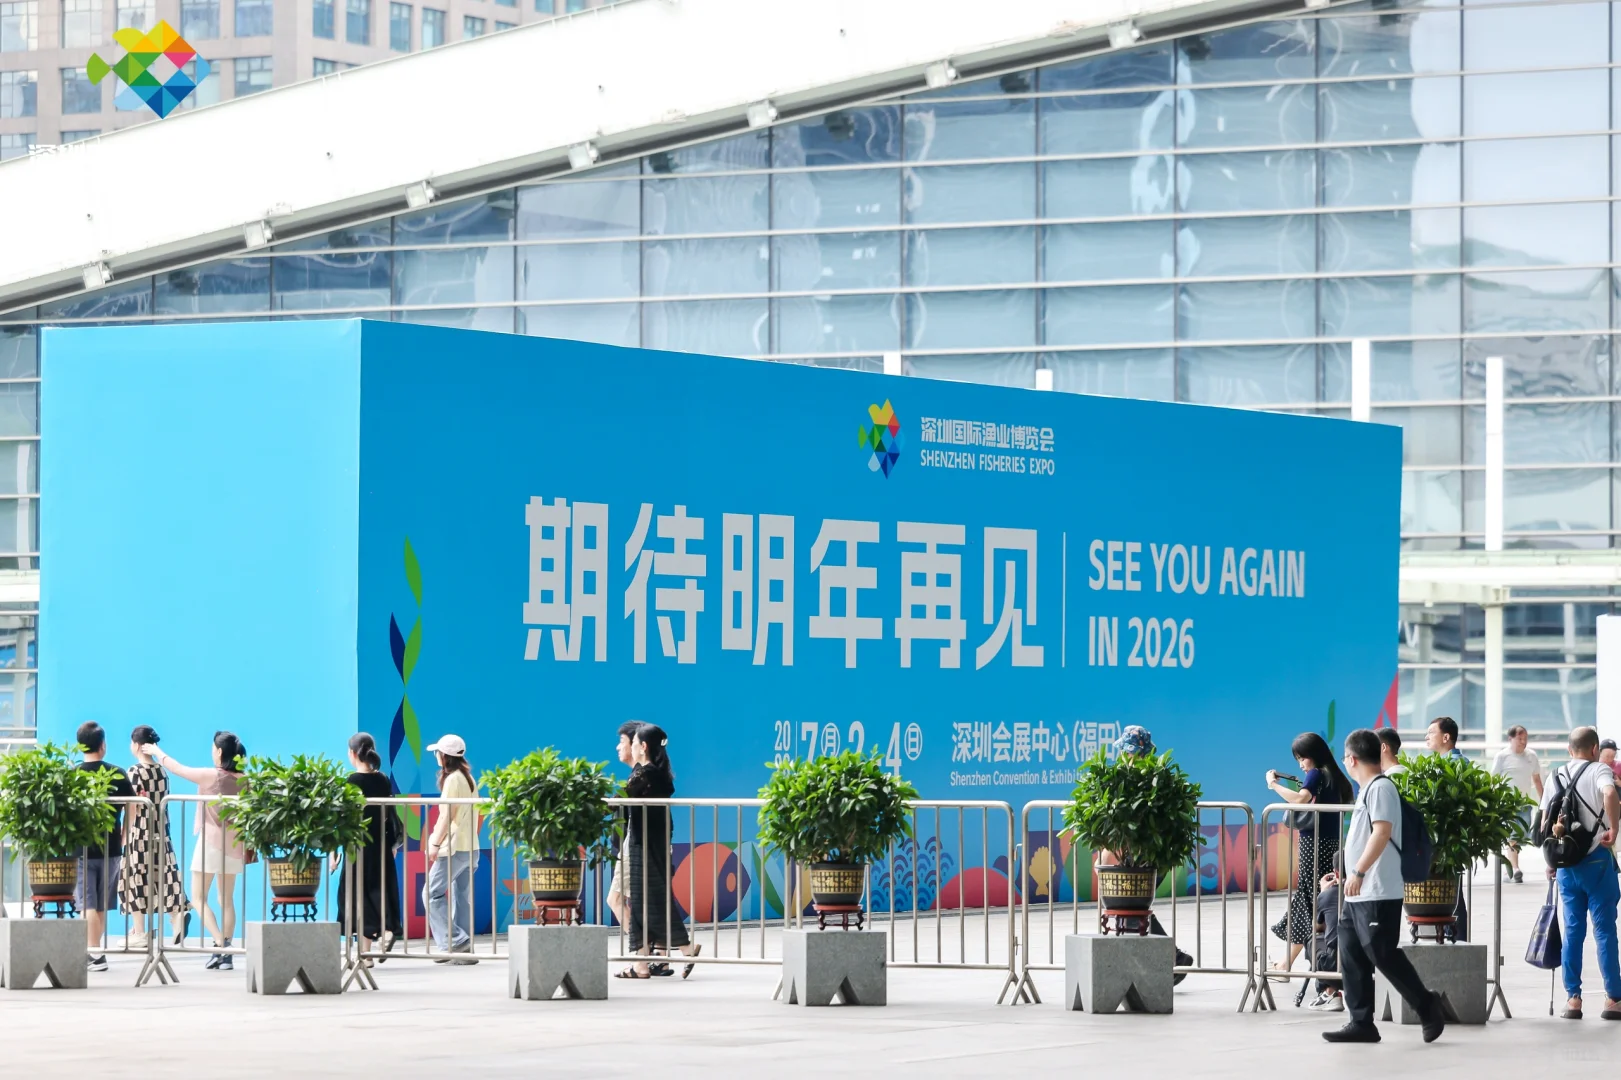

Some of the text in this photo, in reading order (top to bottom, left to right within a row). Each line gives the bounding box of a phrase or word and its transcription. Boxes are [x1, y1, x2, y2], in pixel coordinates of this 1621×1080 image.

[920, 416, 1055, 452] 深圳国际渔业博览会
[920, 449, 1055, 476] SHENZHEN FISHERIES EXPO
[522, 495, 1045, 671] 期待明年再见
[1088, 539, 1305, 598] SEE YOU AGAIN
[1088, 616, 1195, 669] IN 2026
[950, 771, 992, 787] Shenzhen
[993, 770, 1040, 786] Convention
[1041, 770, 1048, 785] &
